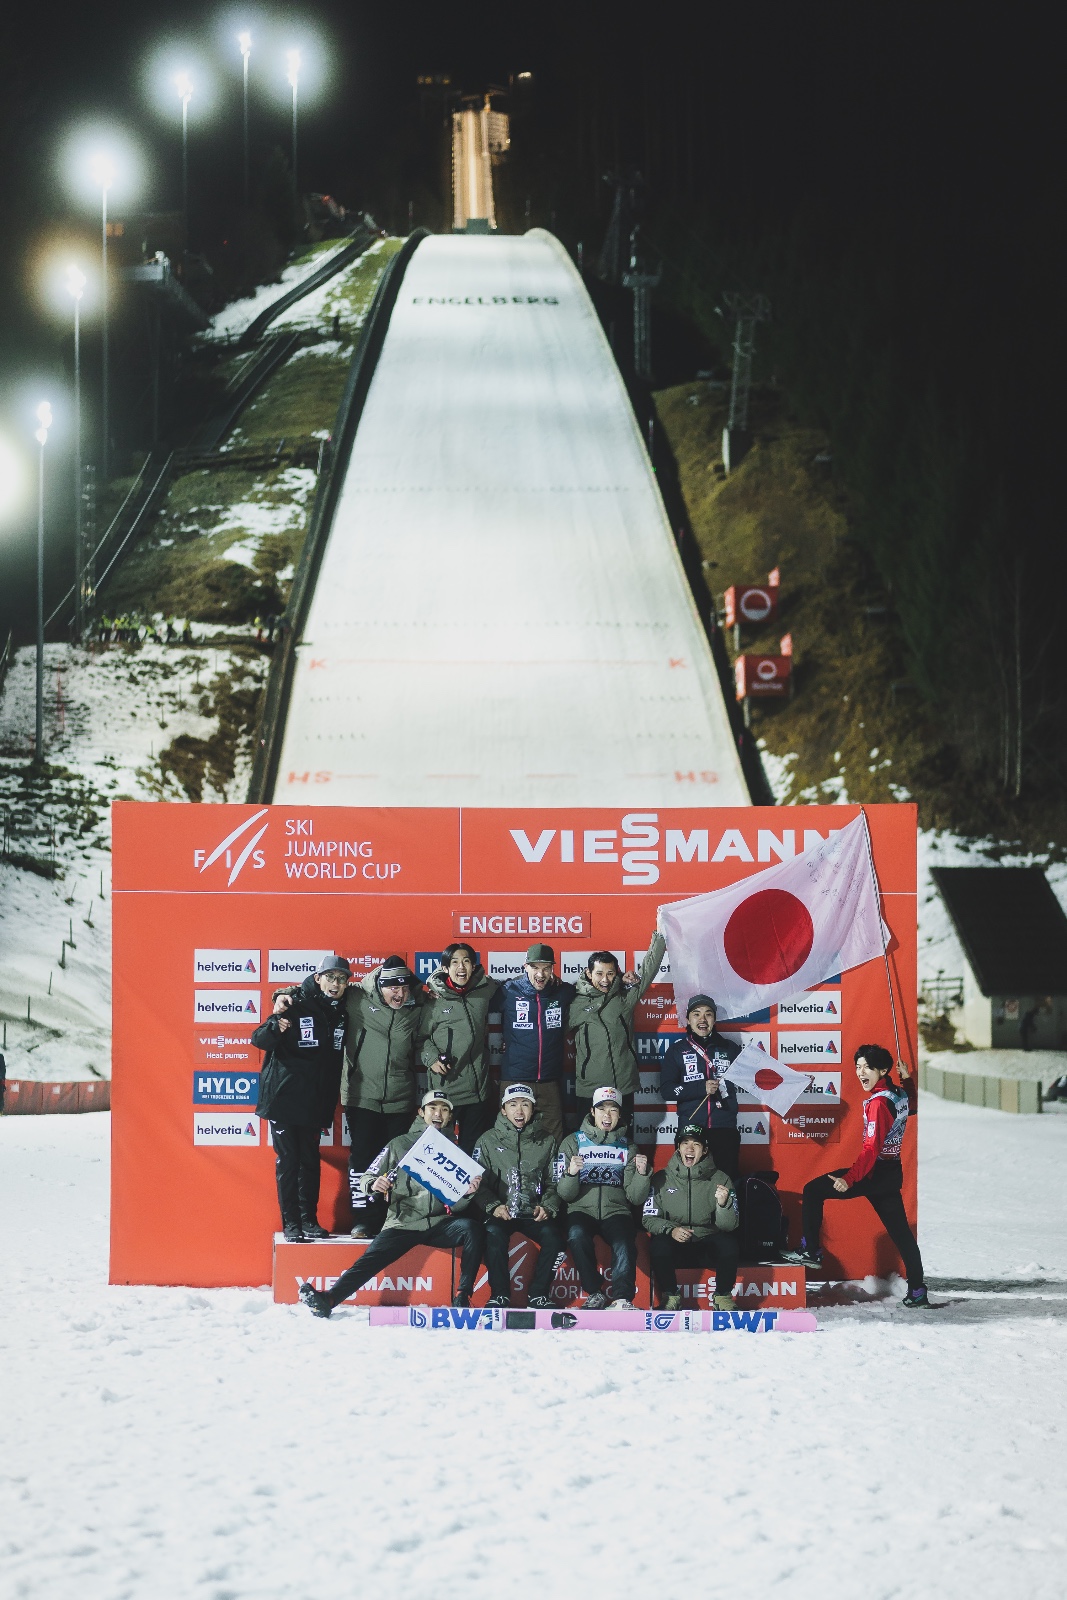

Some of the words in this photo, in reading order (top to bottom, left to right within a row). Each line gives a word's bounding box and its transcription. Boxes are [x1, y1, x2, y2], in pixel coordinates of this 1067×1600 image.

[412, 296, 559, 305] ENGELBERG
[310, 658, 328, 670] K
[669, 658, 688, 669] K
[288, 771, 334, 784] HS
[674, 770, 719, 784] HS
[285, 820, 313, 836] SKI
[285, 841, 373, 858] JUMPING
[285, 863, 357, 879] WORLD
[362, 863, 401, 879] CUP
[459, 916, 584, 934] ENGELBERG
[197, 961, 242, 972] helvetia
[271, 962, 317, 973] helvetia
[347, 956, 386, 968] VIESSMA
[419, 959, 442, 974] HY
[490, 964, 527, 974] helvet
[563, 965, 589, 975] helv
[197, 1002, 243, 1013] helvetia
[640, 997, 677, 1009] VIESSMA
[780, 1003, 824, 1014] helvetia
[646, 1012, 662, 1020] Heat
[780, 1043, 824, 1054] helvetia
[206, 1052, 223, 1060] Heat
[225, 1052, 249, 1061] pumps
[637, 1084, 661, 1094] helv
[782, 1116, 834, 1128] VIESSMANN
[197, 1124, 242, 1135] helvetia
[806, 1131, 829, 1140] pumps
[433, 1152, 471, 1185] カワモト
[588, 1167, 613, 1181] 66
[295, 1270, 433, 1301] VIEMANN
[549, 1286, 588, 1299] ORL
[676, 1277, 796, 1307] IEANN
[713, 1311, 777, 1333] BWT
